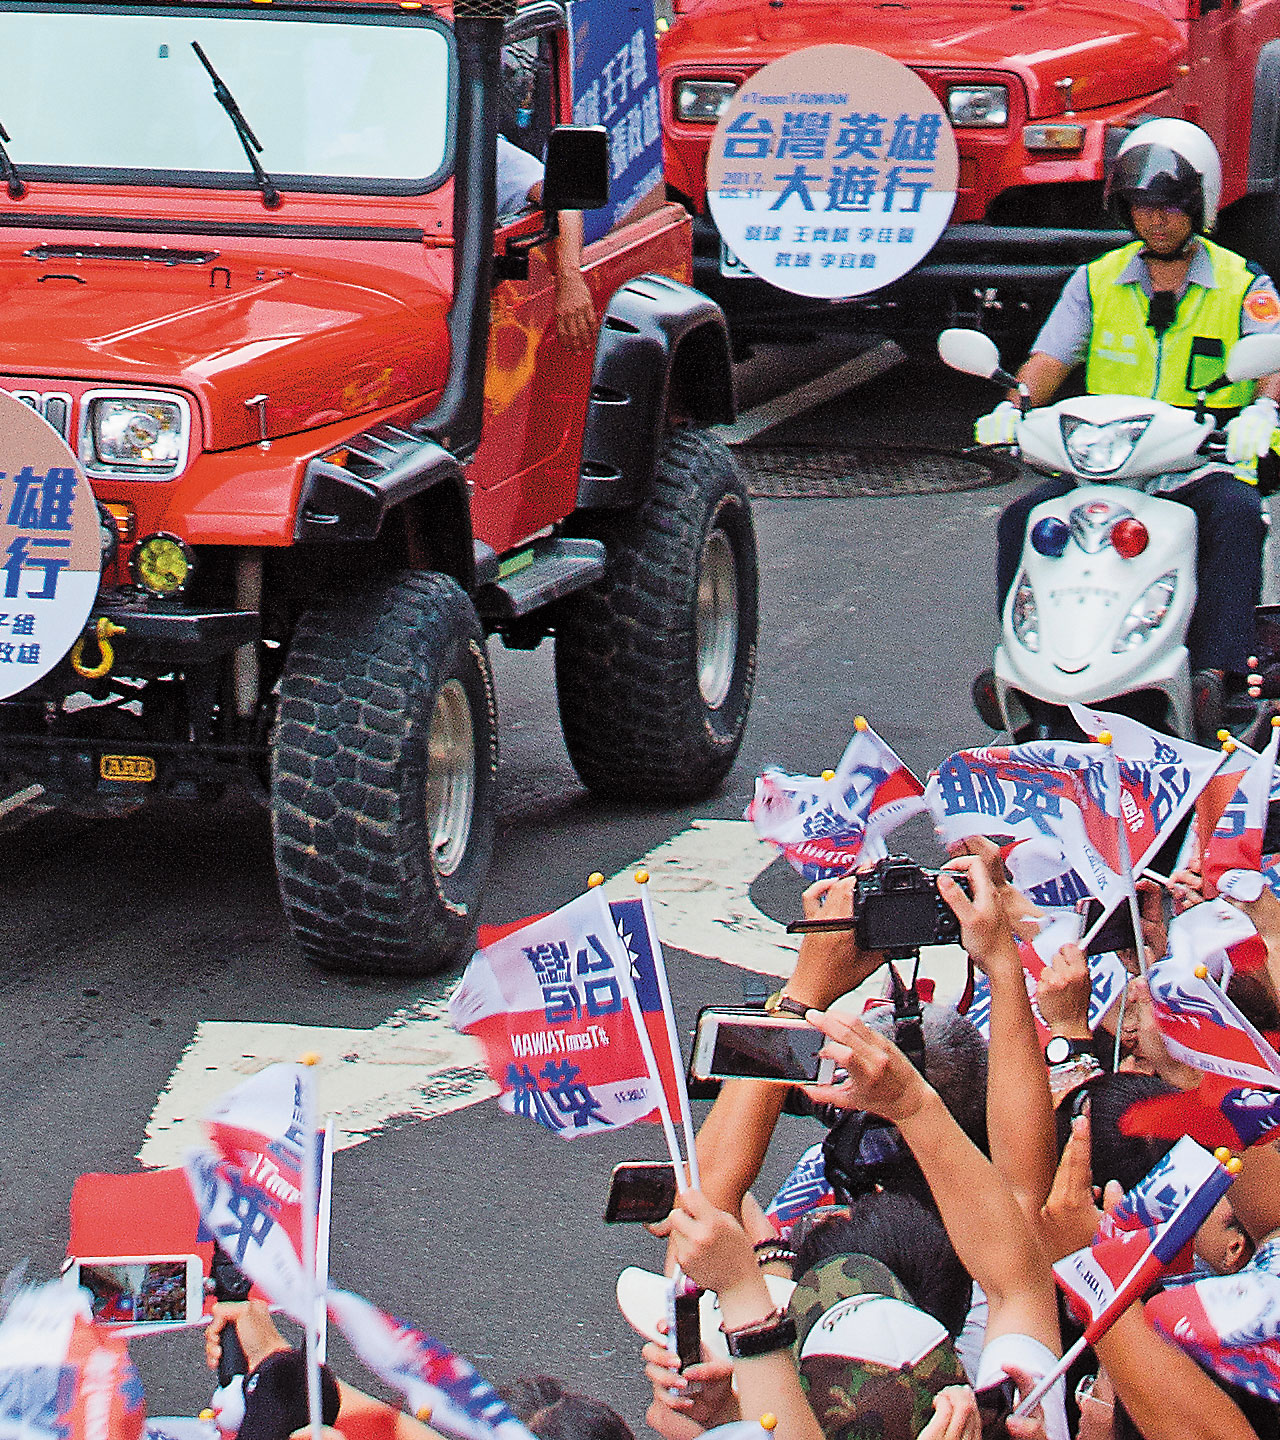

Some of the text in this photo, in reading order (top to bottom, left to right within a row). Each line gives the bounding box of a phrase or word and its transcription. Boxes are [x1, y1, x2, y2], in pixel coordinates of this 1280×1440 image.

[723, 112, 943, 161] 台灣英雄
[768, 165, 934, 212] 大遊行
